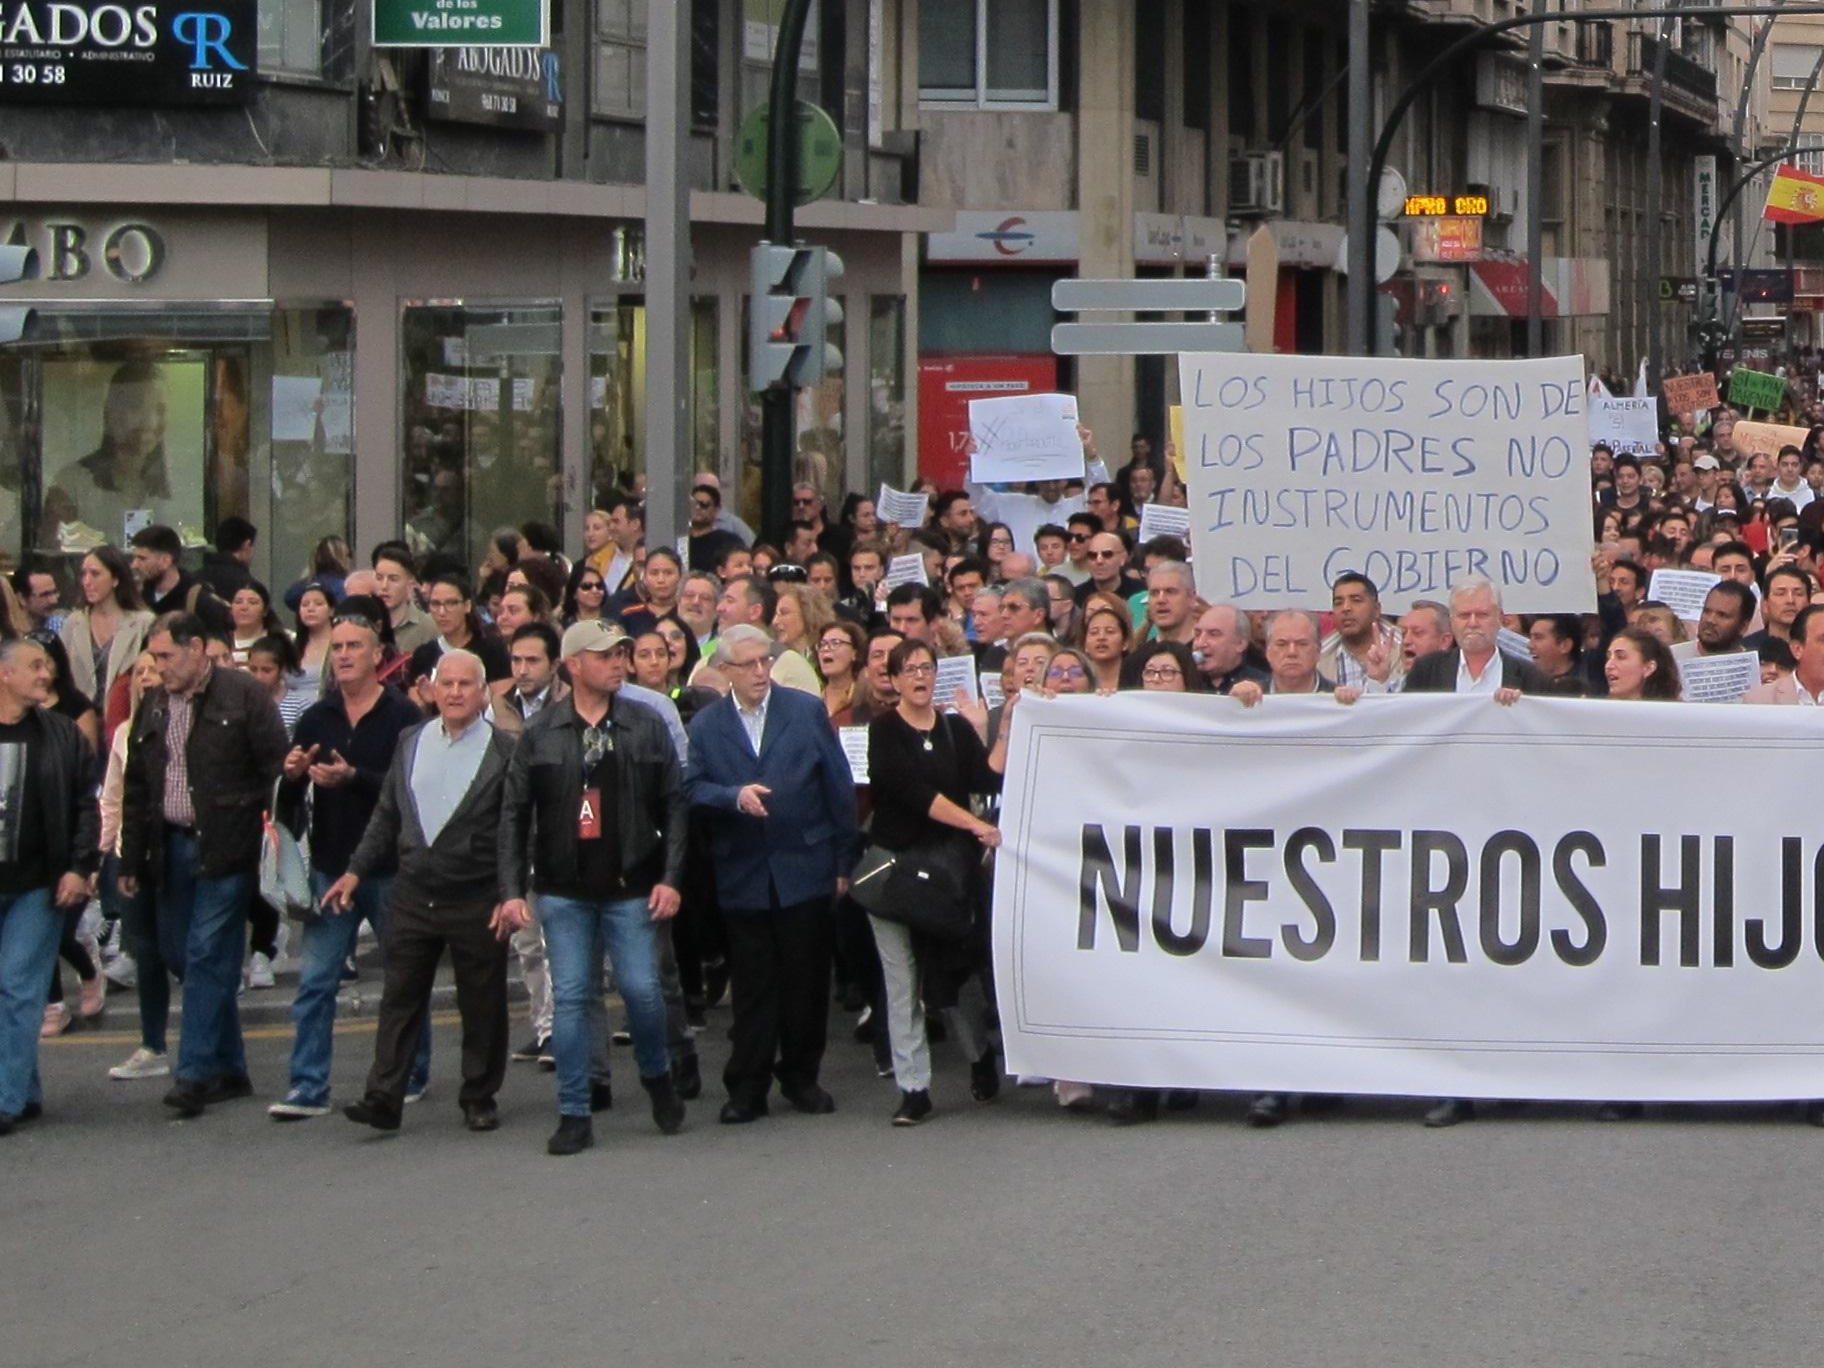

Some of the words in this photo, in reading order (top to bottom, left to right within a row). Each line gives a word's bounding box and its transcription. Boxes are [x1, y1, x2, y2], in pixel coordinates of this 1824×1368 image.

[411, 11, 503, 30] Valores
[12, 64, 37, 84] 30
[41, 64, 66, 84] 58
[190, 73, 233, 89] RUIZ
[1194, 369, 1268, 410] LOS
[1293, 377, 1408, 413] HIJOS
[1429, 379, 1521, 420] SON
[1541, 379, 1582, 420] DE
[1200, 433, 1264, 470] LOS
[1288, 427, 1477, 477] PADRES
[1507, 435, 1572, 479] NO
[1207, 487, 1551, 535] INSTRUMENTOS
[1230, 554, 1308, 599] DEL
[1077, 822, 1609, 968] NUESTROS
